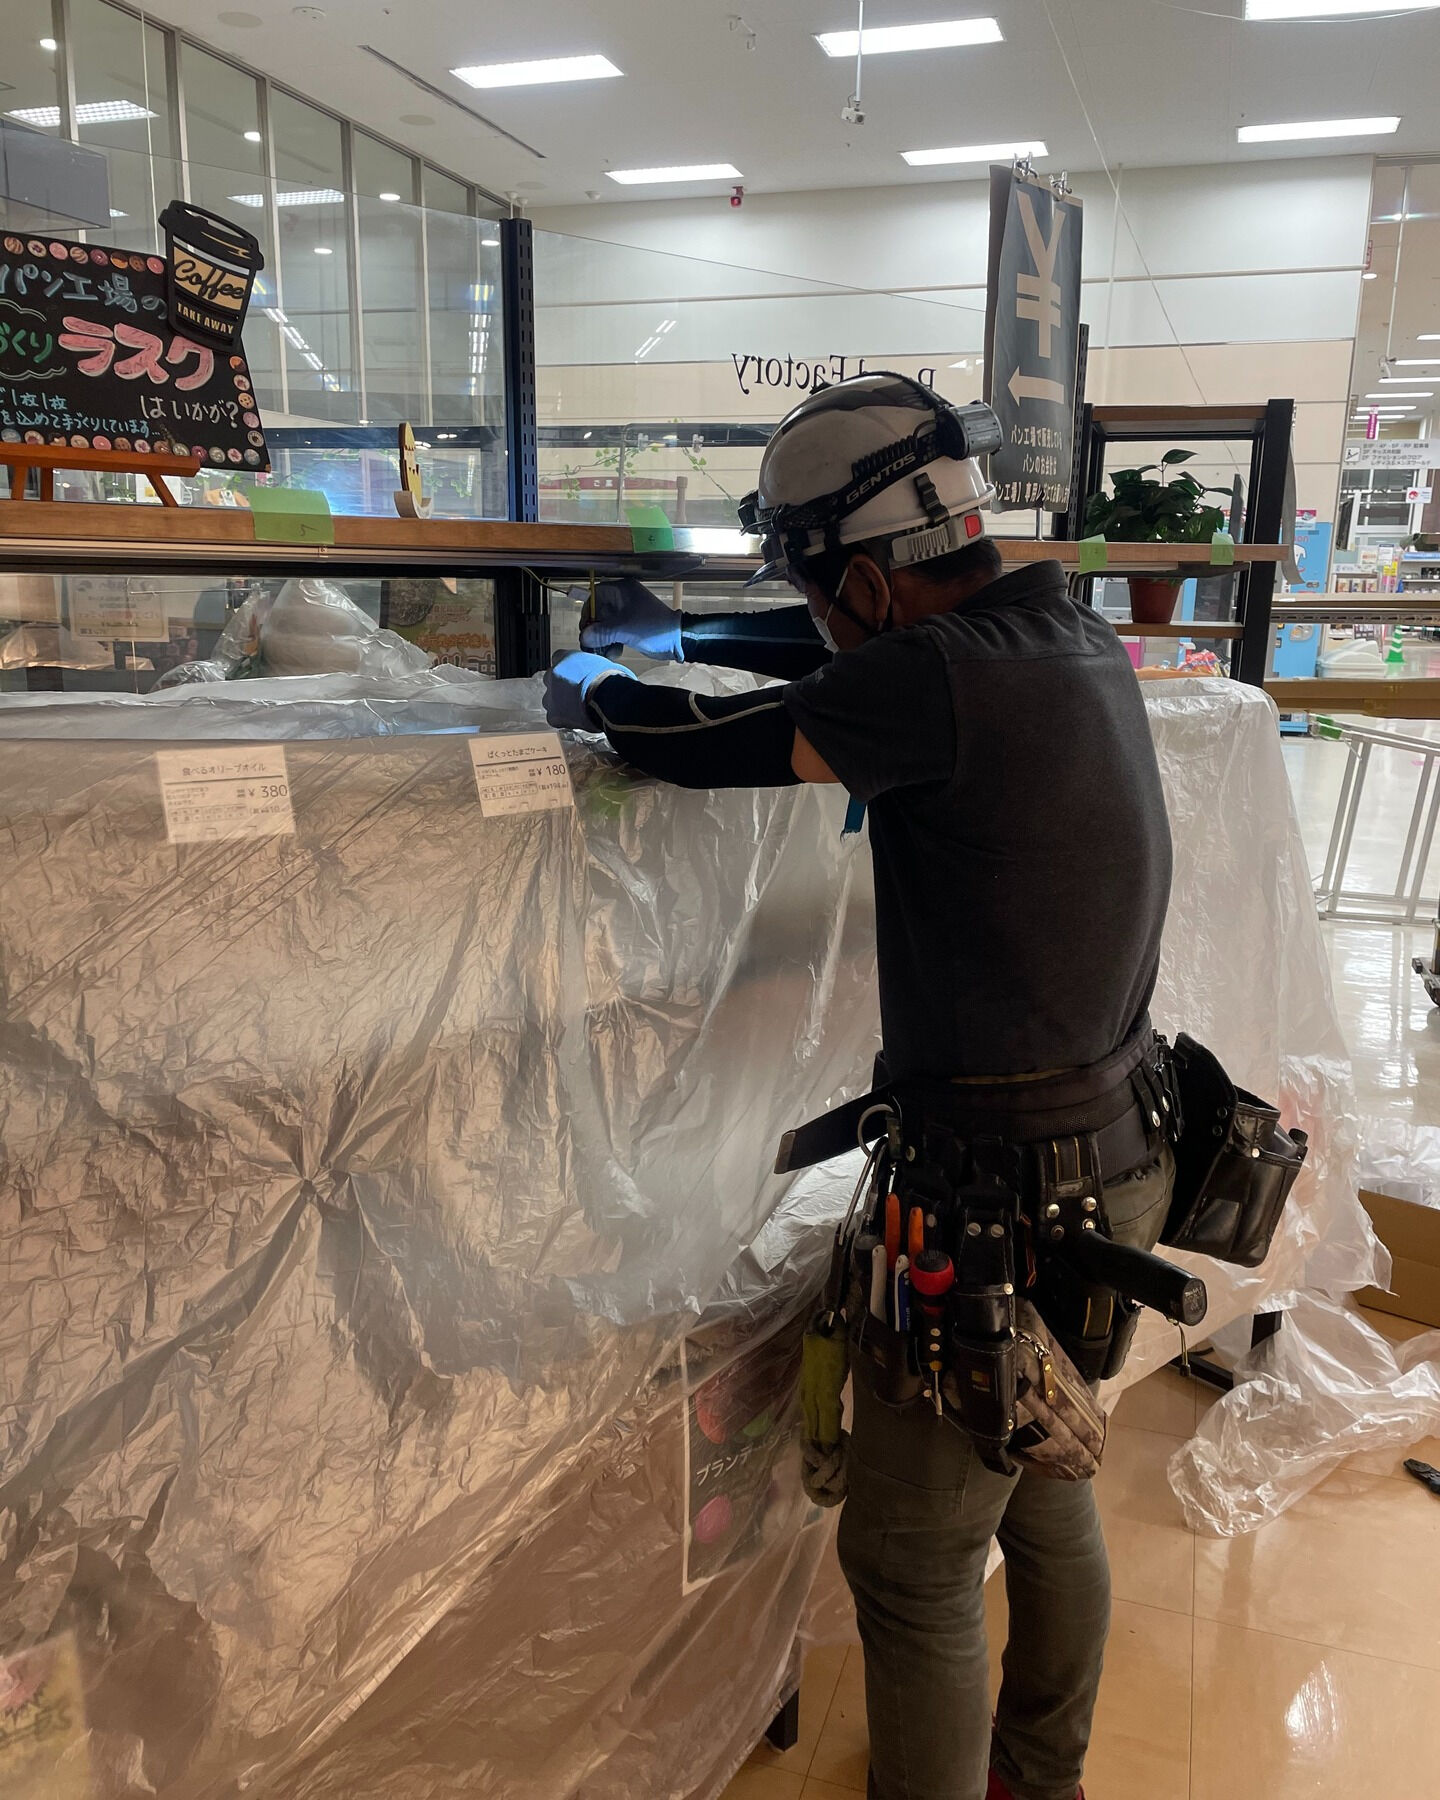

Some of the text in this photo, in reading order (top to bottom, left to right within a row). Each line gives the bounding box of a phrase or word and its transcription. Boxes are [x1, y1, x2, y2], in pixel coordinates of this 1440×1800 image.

[0, 263, 168, 320] パン工場の
[173, 259, 245, 300] Coffee
[176, 303, 234, 335] TAKE AWAY
[58, 316, 215, 391] ラスク
[846, 451, 917, 504] GENTOS
[546, 763, 566, 776] 180
[261, 784, 288, 798] 380
